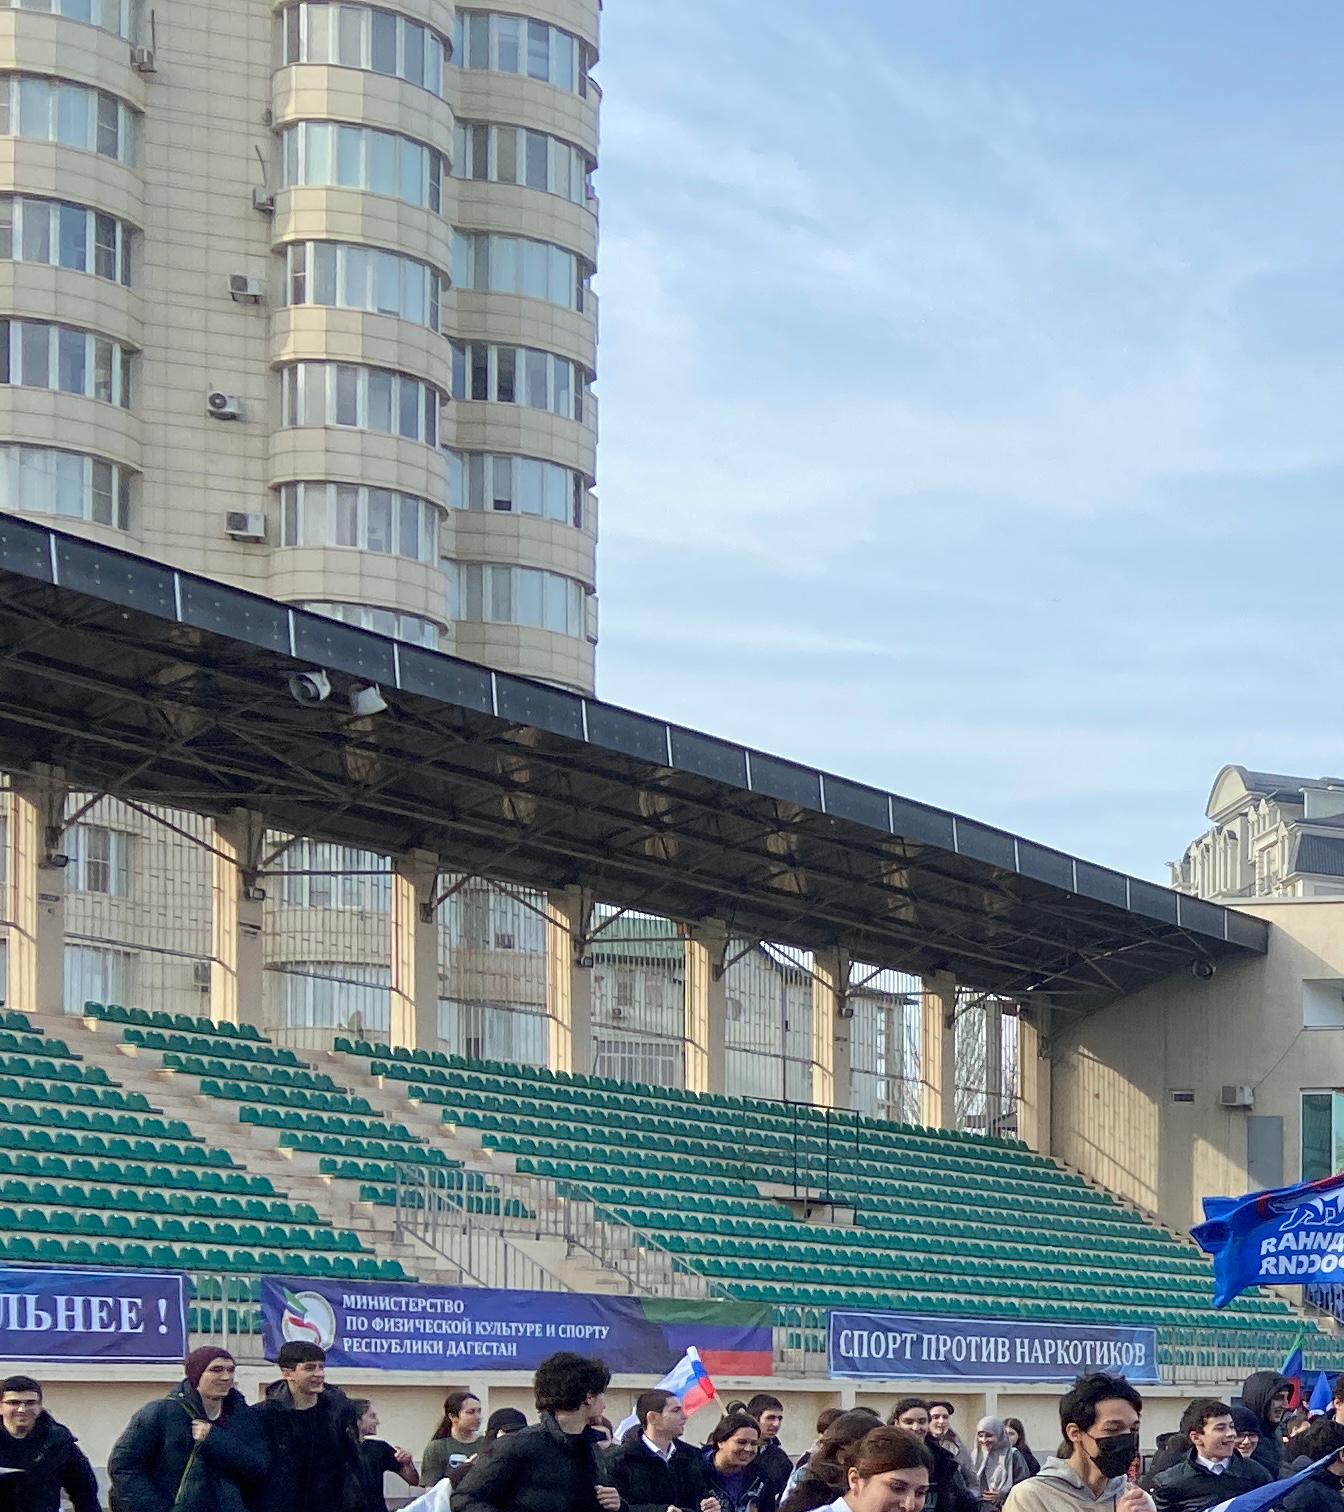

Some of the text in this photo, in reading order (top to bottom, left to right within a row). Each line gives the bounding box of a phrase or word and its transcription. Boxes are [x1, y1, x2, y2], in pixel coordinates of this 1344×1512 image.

[342, 1294, 465, 1314] МИНИСТЕРСТВО
[346, 1315, 610, 1340] ПО ФИЗИЧЕСКОЙ КУЛЬТУРЕ И СПОРТУ
[343, 1337, 517, 1357] РЕСПУБЛИКИ ДАГЕСТАН
[839, 1329, 1146, 1367] СПОРТ ПРОТИВ НАРКОТИКОВ
